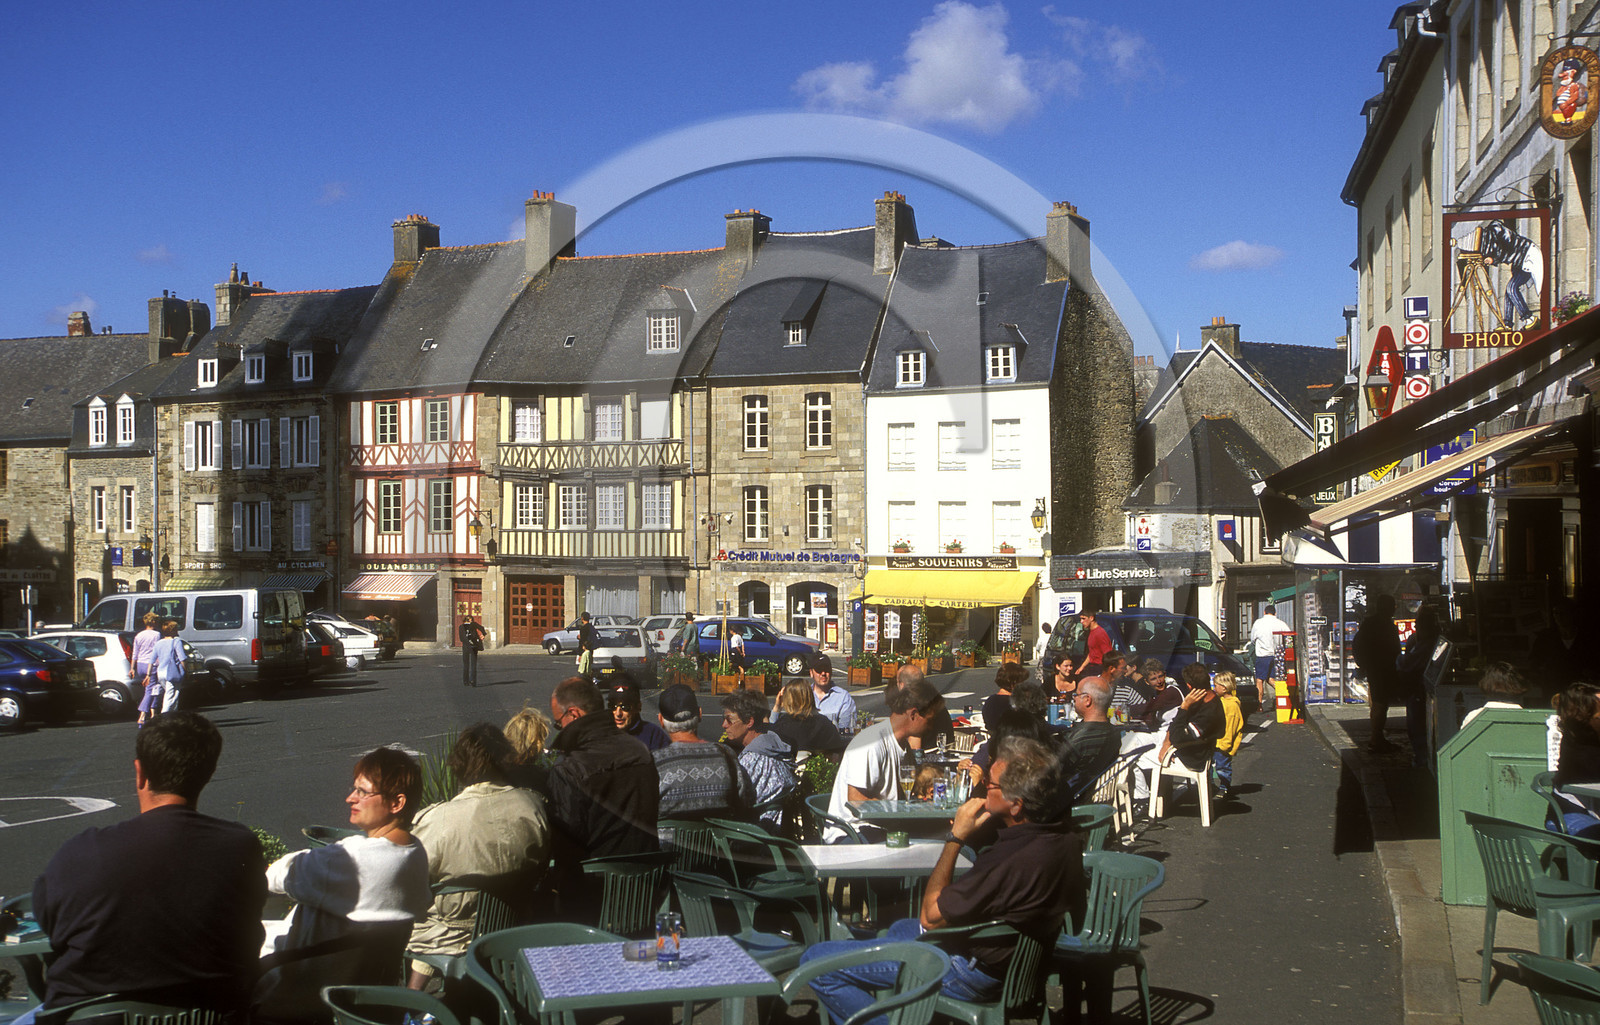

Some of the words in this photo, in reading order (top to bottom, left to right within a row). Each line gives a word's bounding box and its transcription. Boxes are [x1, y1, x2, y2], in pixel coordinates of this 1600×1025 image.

[1463, 332, 1524, 347] PHOTO
[1316, 491, 1336, 501] JEUX
[728, 550, 758, 561] Crédit
[760, 551, 794, 561] Mutuel
[797, 552, 809, 561] de
[812, 551, 860, 564] Bretagne
[918, 557, 983, 567] SOUVENIRS
[291, 561, 325, 569] CYCLAMEN
[1086, 568, 1111, 579] Libre
[1112, 567, 1149, 578] Service
[939, 600, 983, 608] CARTERIE
